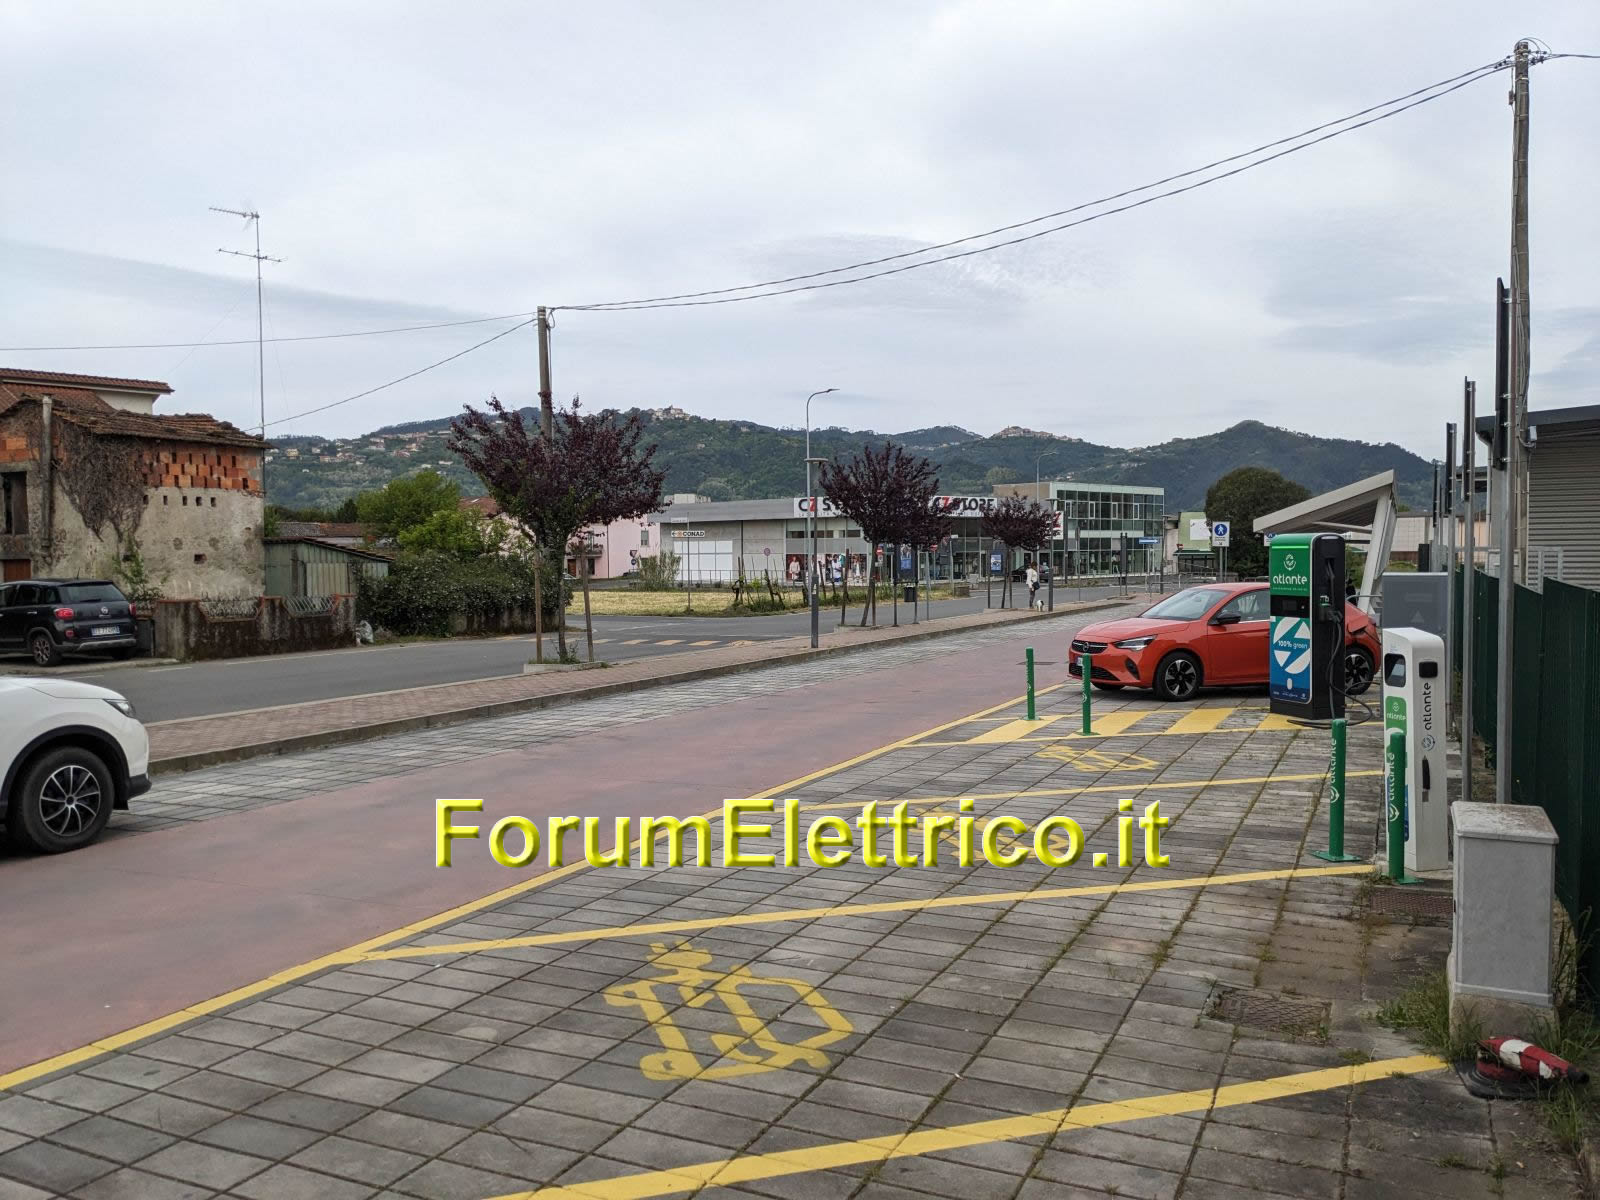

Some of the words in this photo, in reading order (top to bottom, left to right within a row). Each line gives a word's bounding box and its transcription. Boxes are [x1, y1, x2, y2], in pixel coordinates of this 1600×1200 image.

[1272, 573, 1308, 585] atlante
[1278, 640, 1293, 648] 100%
[1293, 642, 1308, 650] green
[1422, 682, 1432, 731] atlante
[1386, 712, 1407, 720] atlante
